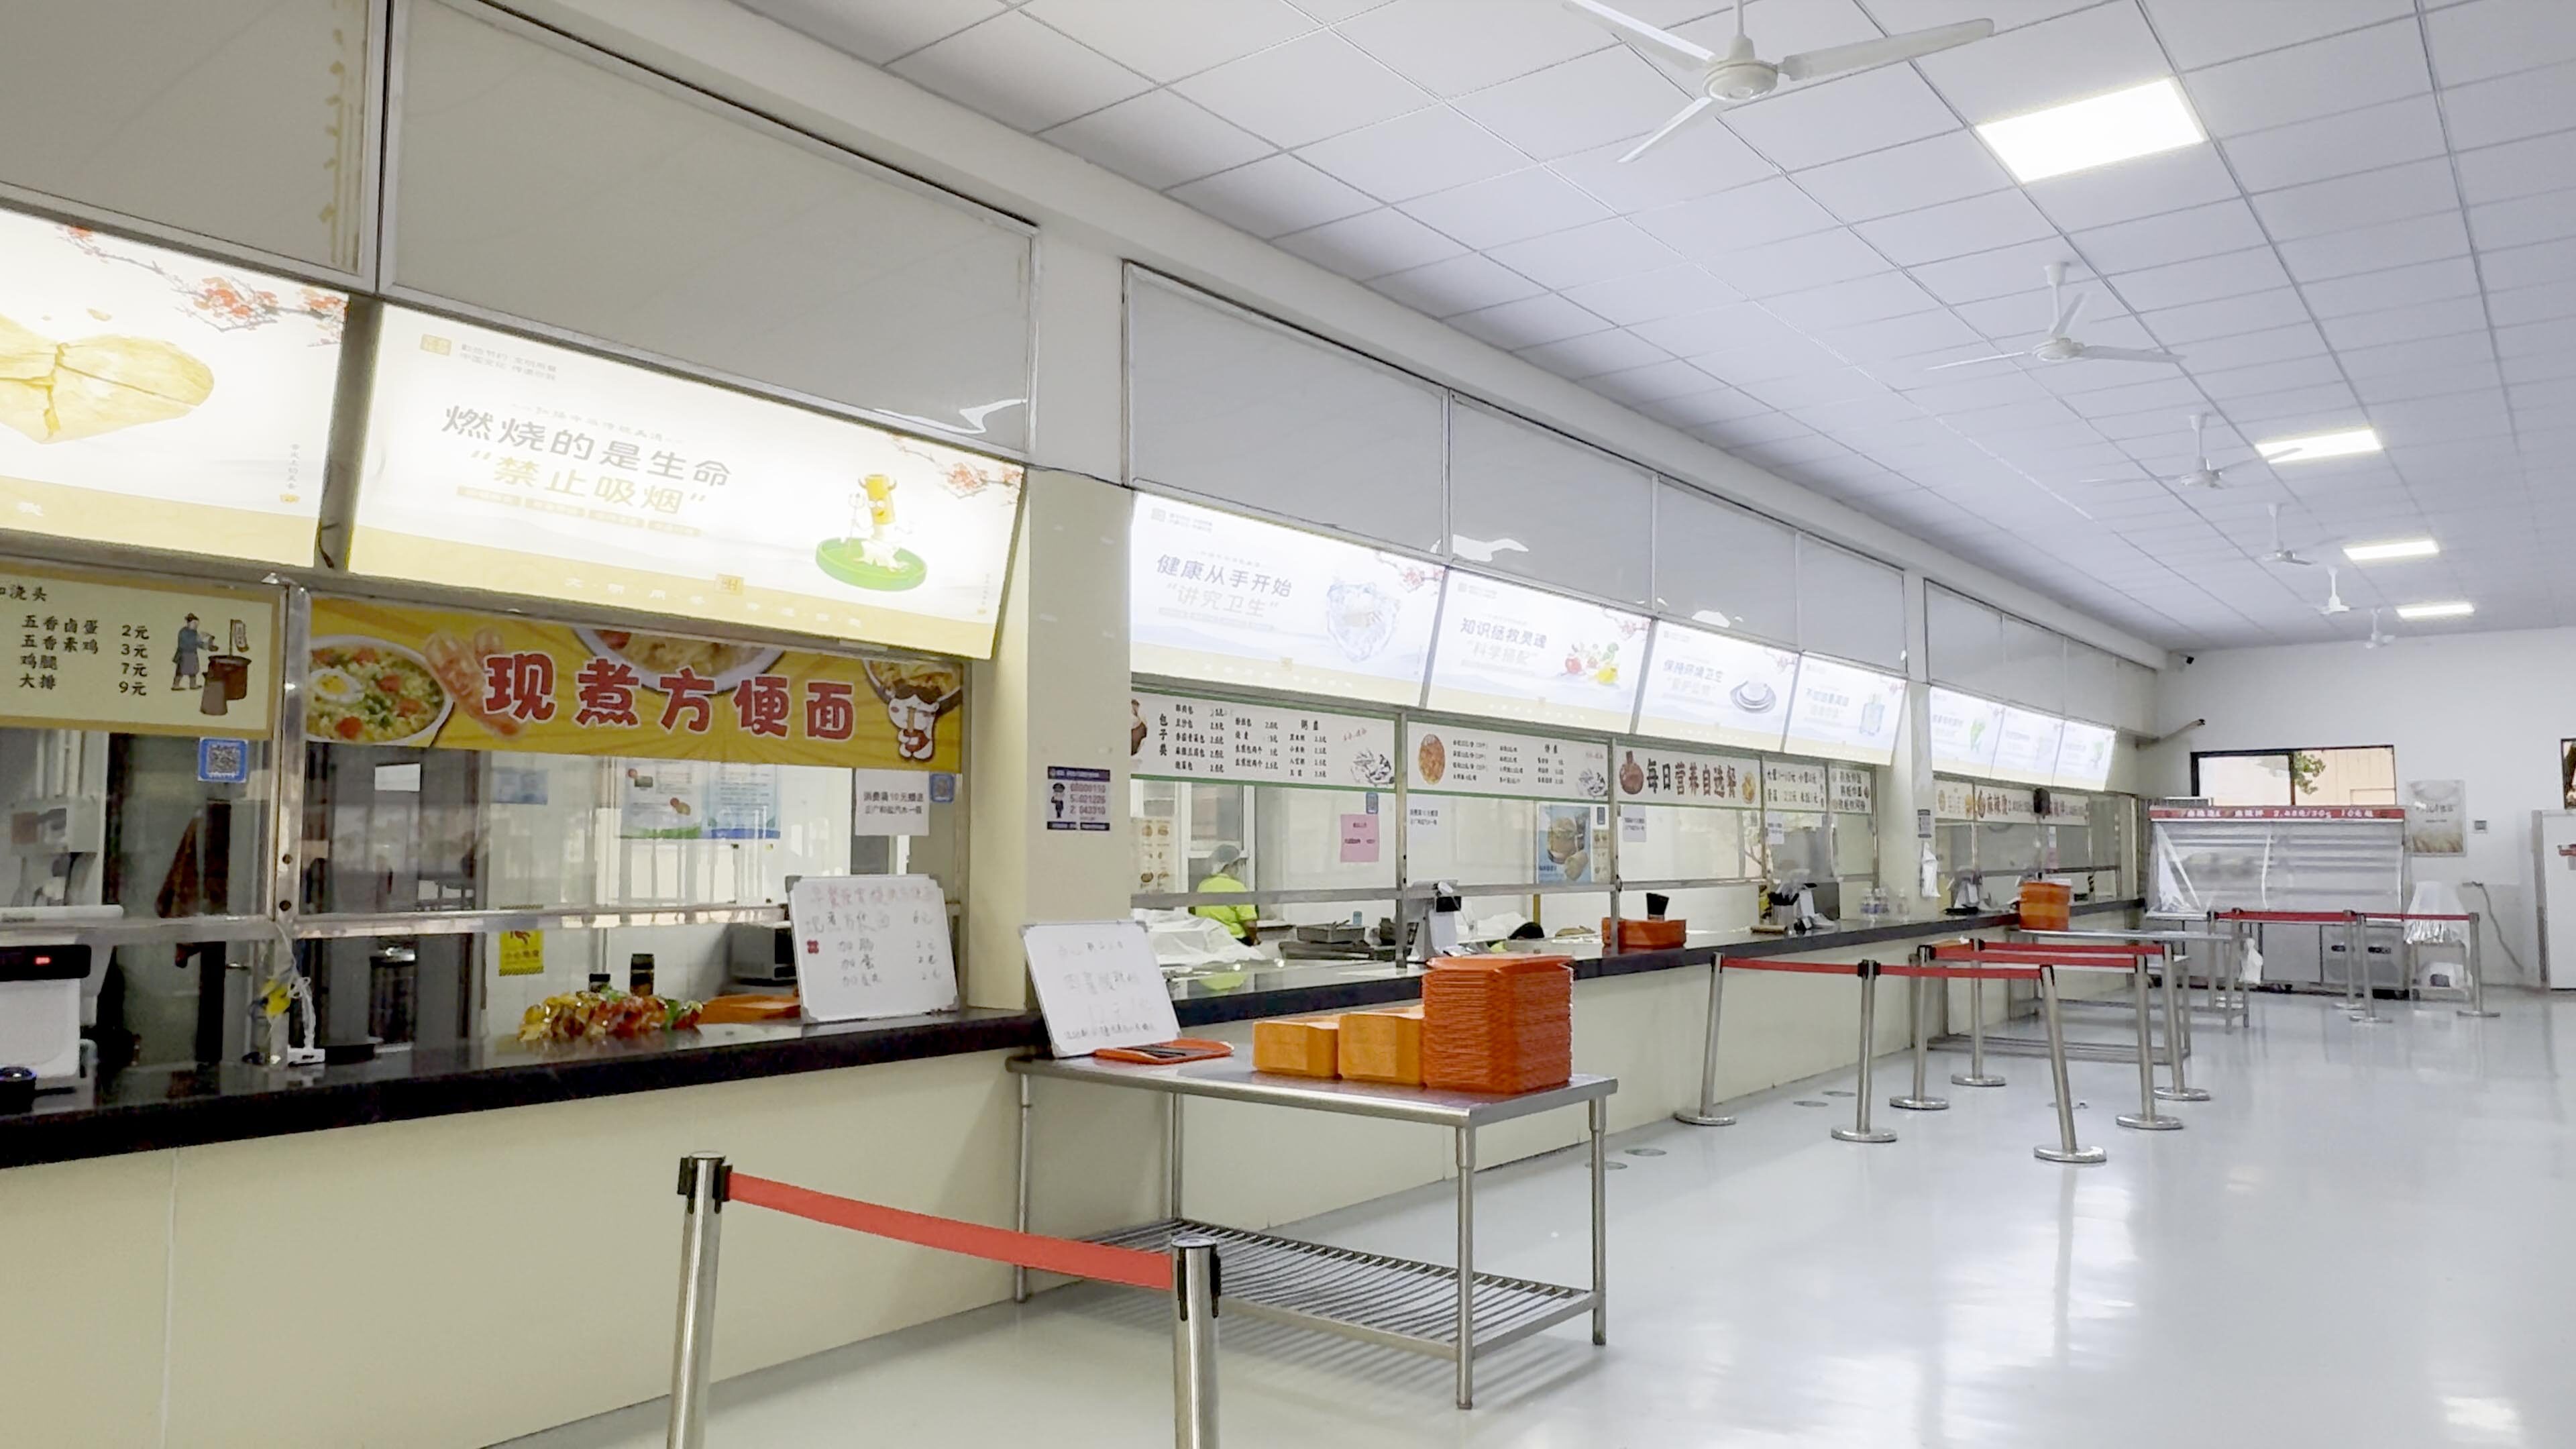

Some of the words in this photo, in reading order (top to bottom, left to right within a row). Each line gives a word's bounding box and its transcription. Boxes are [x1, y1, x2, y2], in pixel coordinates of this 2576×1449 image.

[441, 405, 731, 487] 燃烧的是生命
[471, 449, 706, 515] “禁止吸烟”
[1157, 553, 1293, 598] 健康从手开始
[21, 614, 99, 635] 五香卤蛋
[121, 624, 150, 641] 2元
[21, 635, 99, 654] 五香素鸡
[120, 643, 148, 659] 3元
[18, 673, 57, 691] 大排
[118, 680, 148, 697] 9元
[19, 653, 58, 671] 鸡腿
[120, 661, 148, 678] 7元
[483, 650, 855, 743] 现煮方便面
[1646, 757, 1737, 799] 每日营养自选餐
